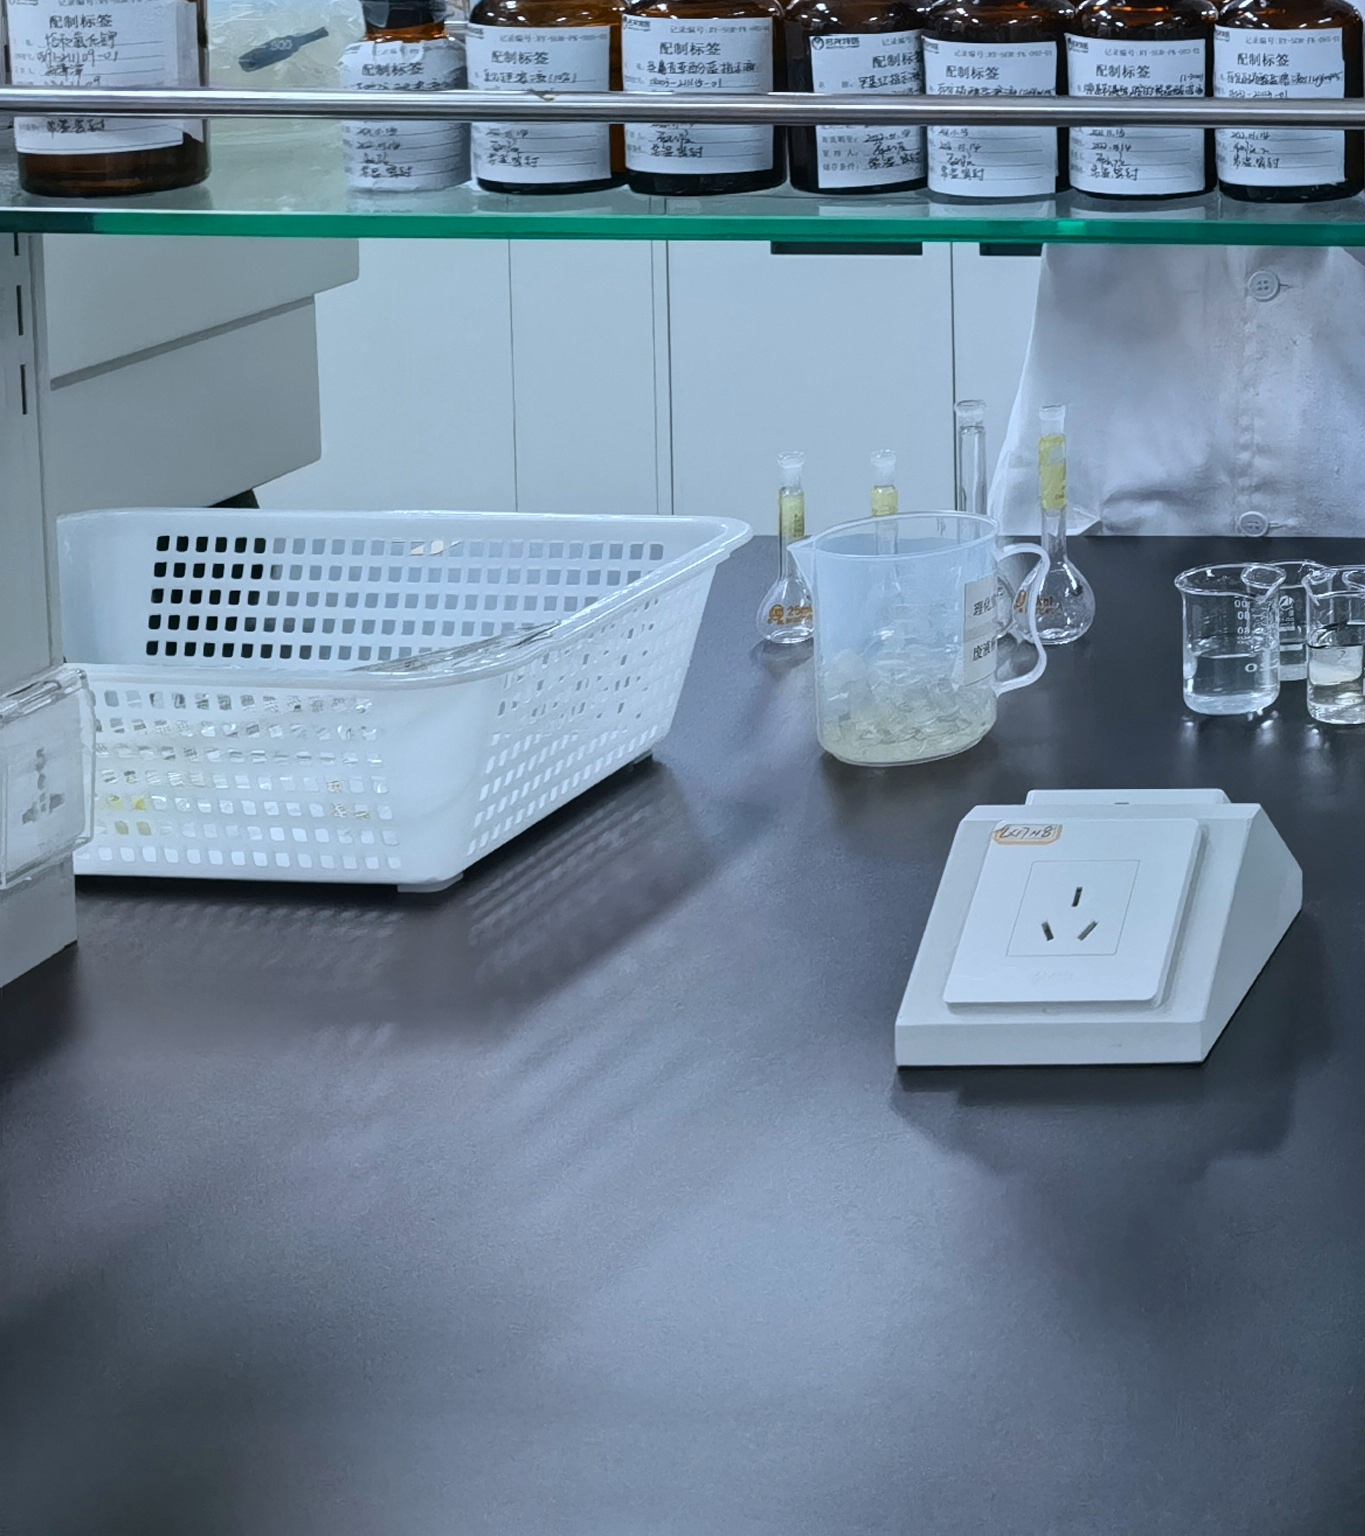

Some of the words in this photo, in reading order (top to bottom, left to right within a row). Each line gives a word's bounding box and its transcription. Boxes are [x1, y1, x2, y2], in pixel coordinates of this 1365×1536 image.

[49, 14, 112, 29] 配制标签
[660, 42, 721, 56] 配制标签
[491, 51, 549, 65] 配制标签
[1237, 53, 1289, 66] 配制标签
[362, 63, 423, 77] 配制标签
[945, 65, 999, 80] 配制标签
[1096, 65, 1151, 79] 配制标签
